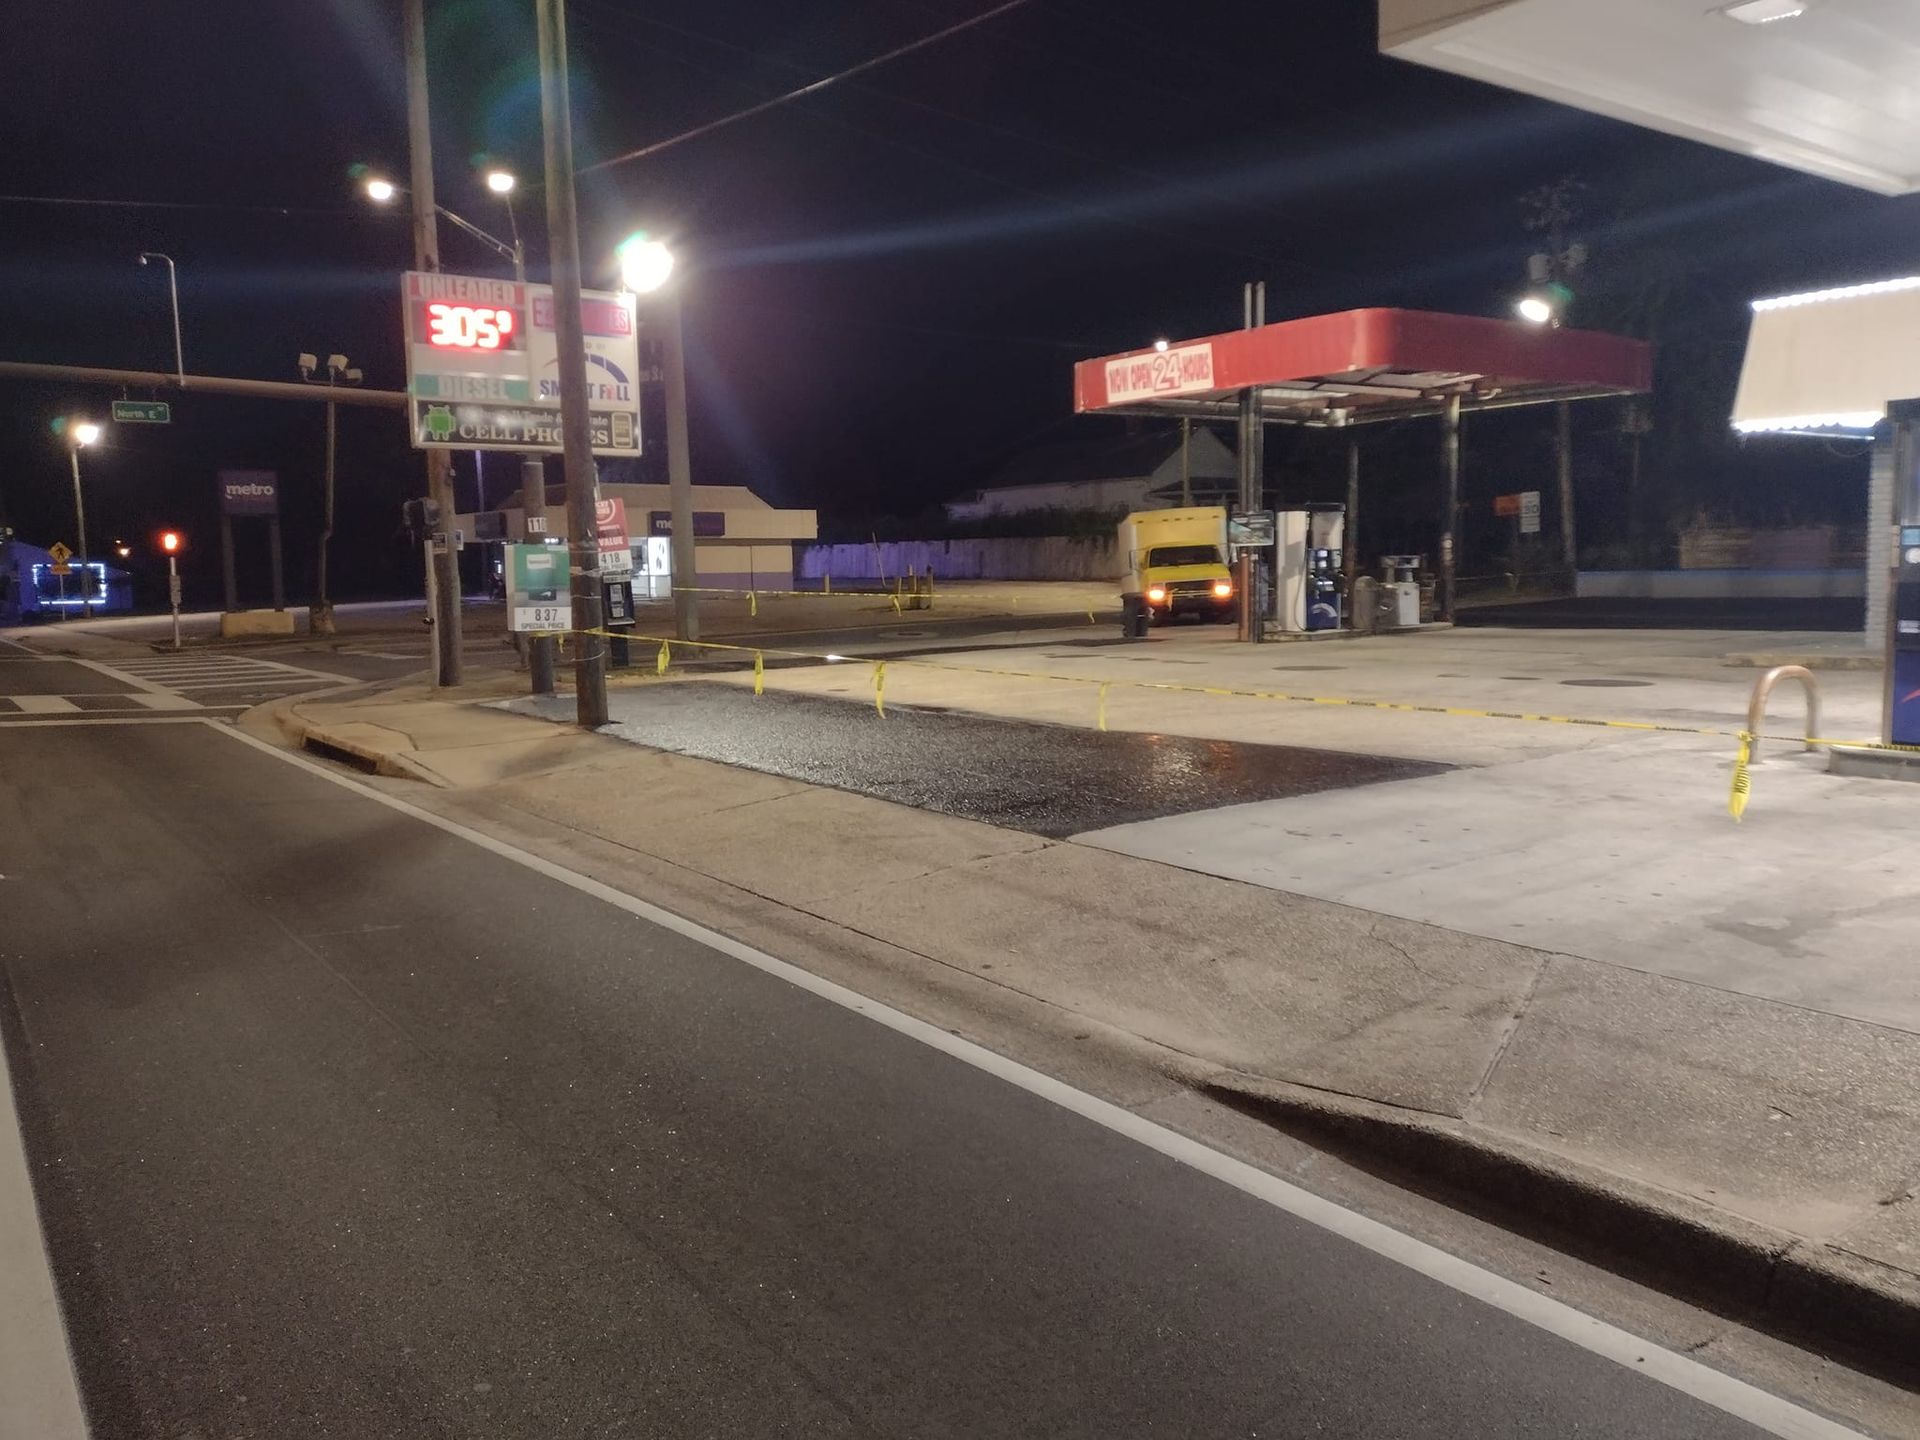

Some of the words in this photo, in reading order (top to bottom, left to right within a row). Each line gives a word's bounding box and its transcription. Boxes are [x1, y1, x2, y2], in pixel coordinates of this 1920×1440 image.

[418, 275, 516, 304] UNLEADED
[1131, 362, 1153, 390] OPEN
[1153, 352, 1181, 392] 24
[1181, 353, 1209, 383] HOURS
[438, 376, 507, 399] DIESEL
[540, 380, 595, 399] SMT
[459, 423, 517, 441] CELL
[522, 426, 609, 445] PHOES
[225, 483, 274, 500] metro
[598, 536, 623, 547] VALUE
